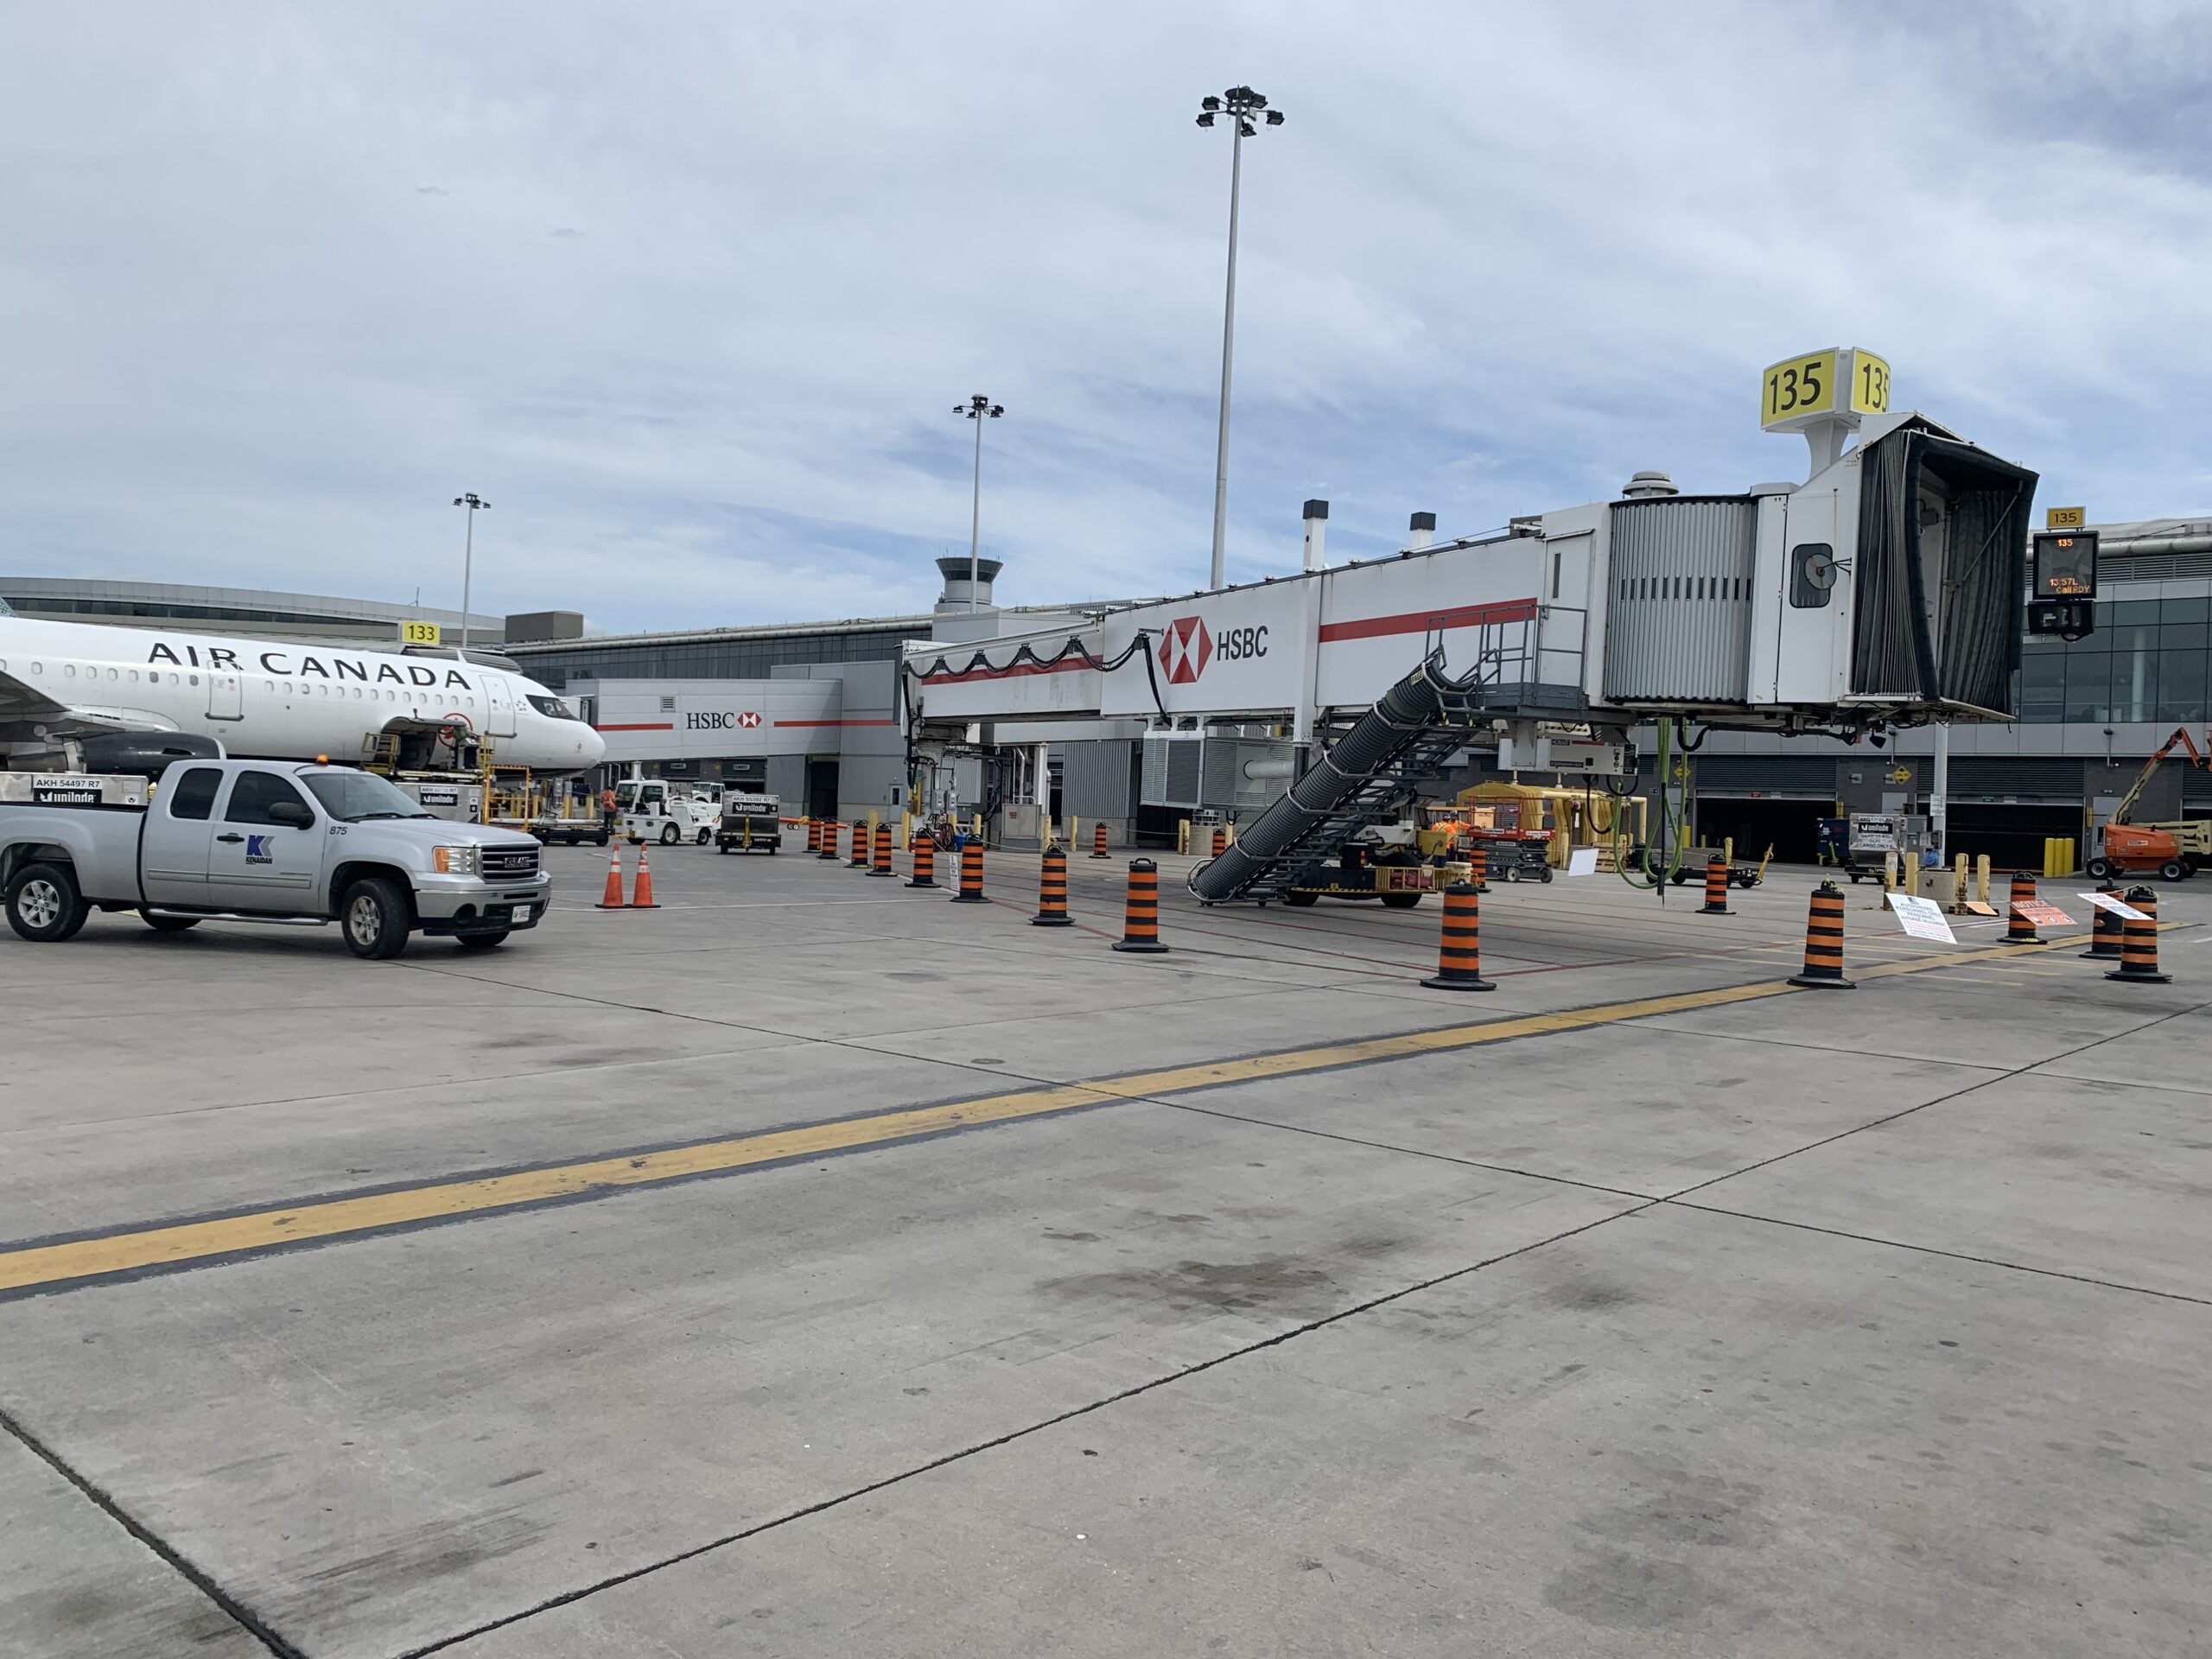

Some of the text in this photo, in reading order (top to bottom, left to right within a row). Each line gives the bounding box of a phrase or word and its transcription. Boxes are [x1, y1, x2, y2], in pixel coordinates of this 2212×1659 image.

[1770, 361, 1821, 415] 135
[1863, 363, 1889, 413] 135
[2055, 512, 2077, 524] 135
[2057, 538, 2073, 547] 135
[2050, 578, 2078, 587] 13:57L
[2056, 586, 2072, 594] Call
[408, 624, 435, 641] 133
[1217, 626, 1268, 661] HSBC
[148, 642, 472, 690] AIR CANADA
[686, 712, 735, 729] HSBC
[54, 791, 94, 803] unilode
[743, 804, 766, 812] unilode
[329, 826, 347, 836] 875
[504, 856, 530, 868] GMC
[2012, 899, 2051, 908] NOTICE
